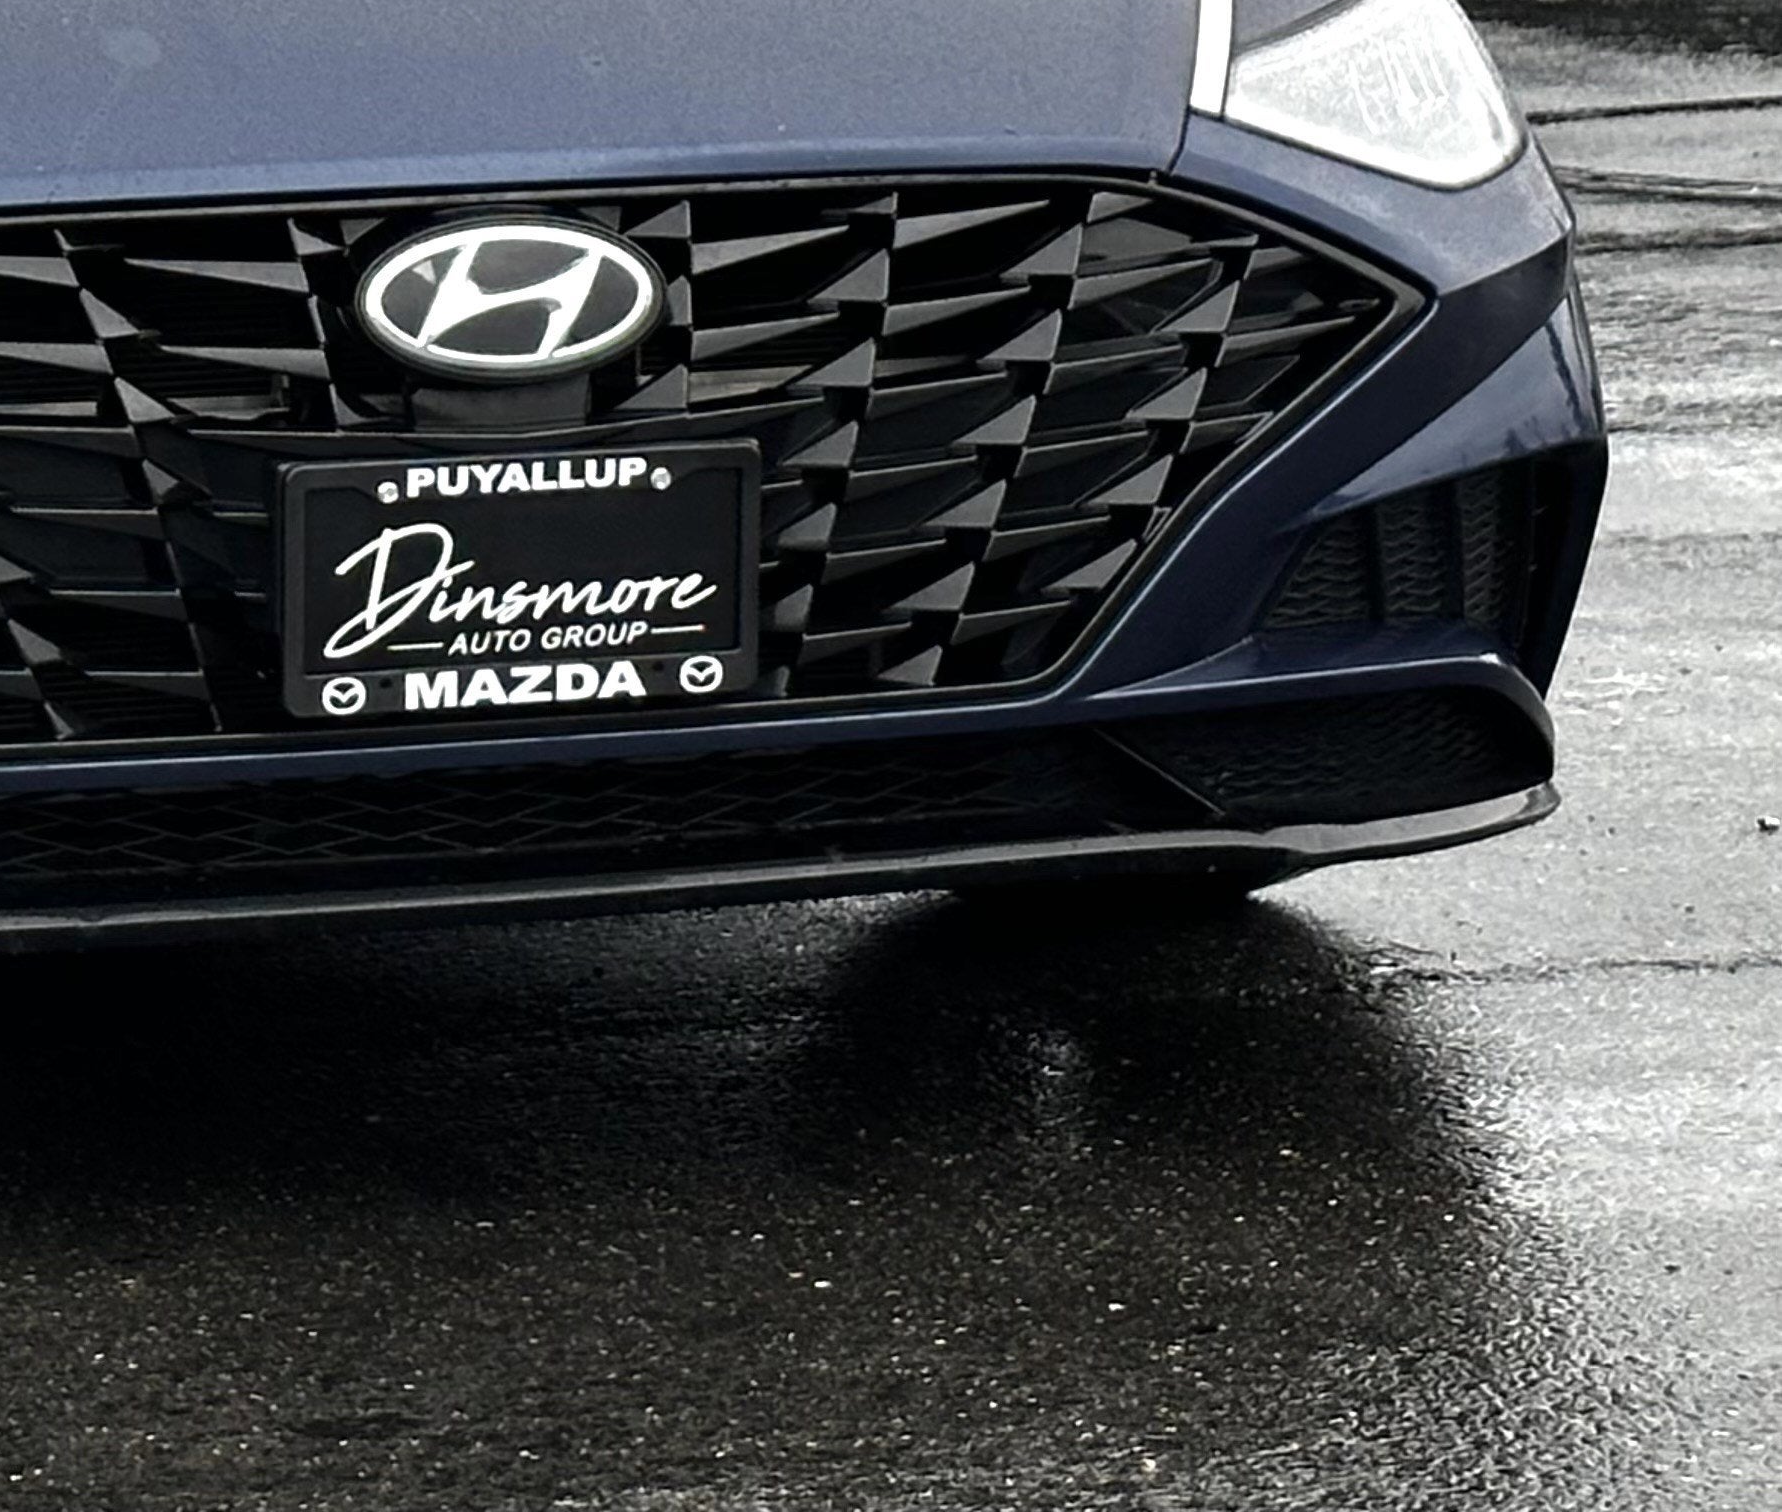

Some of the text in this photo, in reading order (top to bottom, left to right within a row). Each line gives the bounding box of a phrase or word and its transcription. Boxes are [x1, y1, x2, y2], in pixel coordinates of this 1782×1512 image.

[406, 457, 648, 498] PUYALLUP
[323, 522, 718, 658] Dinsmore
[448, 622, 649, 656] AUTO GROUP
[404, 660, 647, 711] MAZDA
